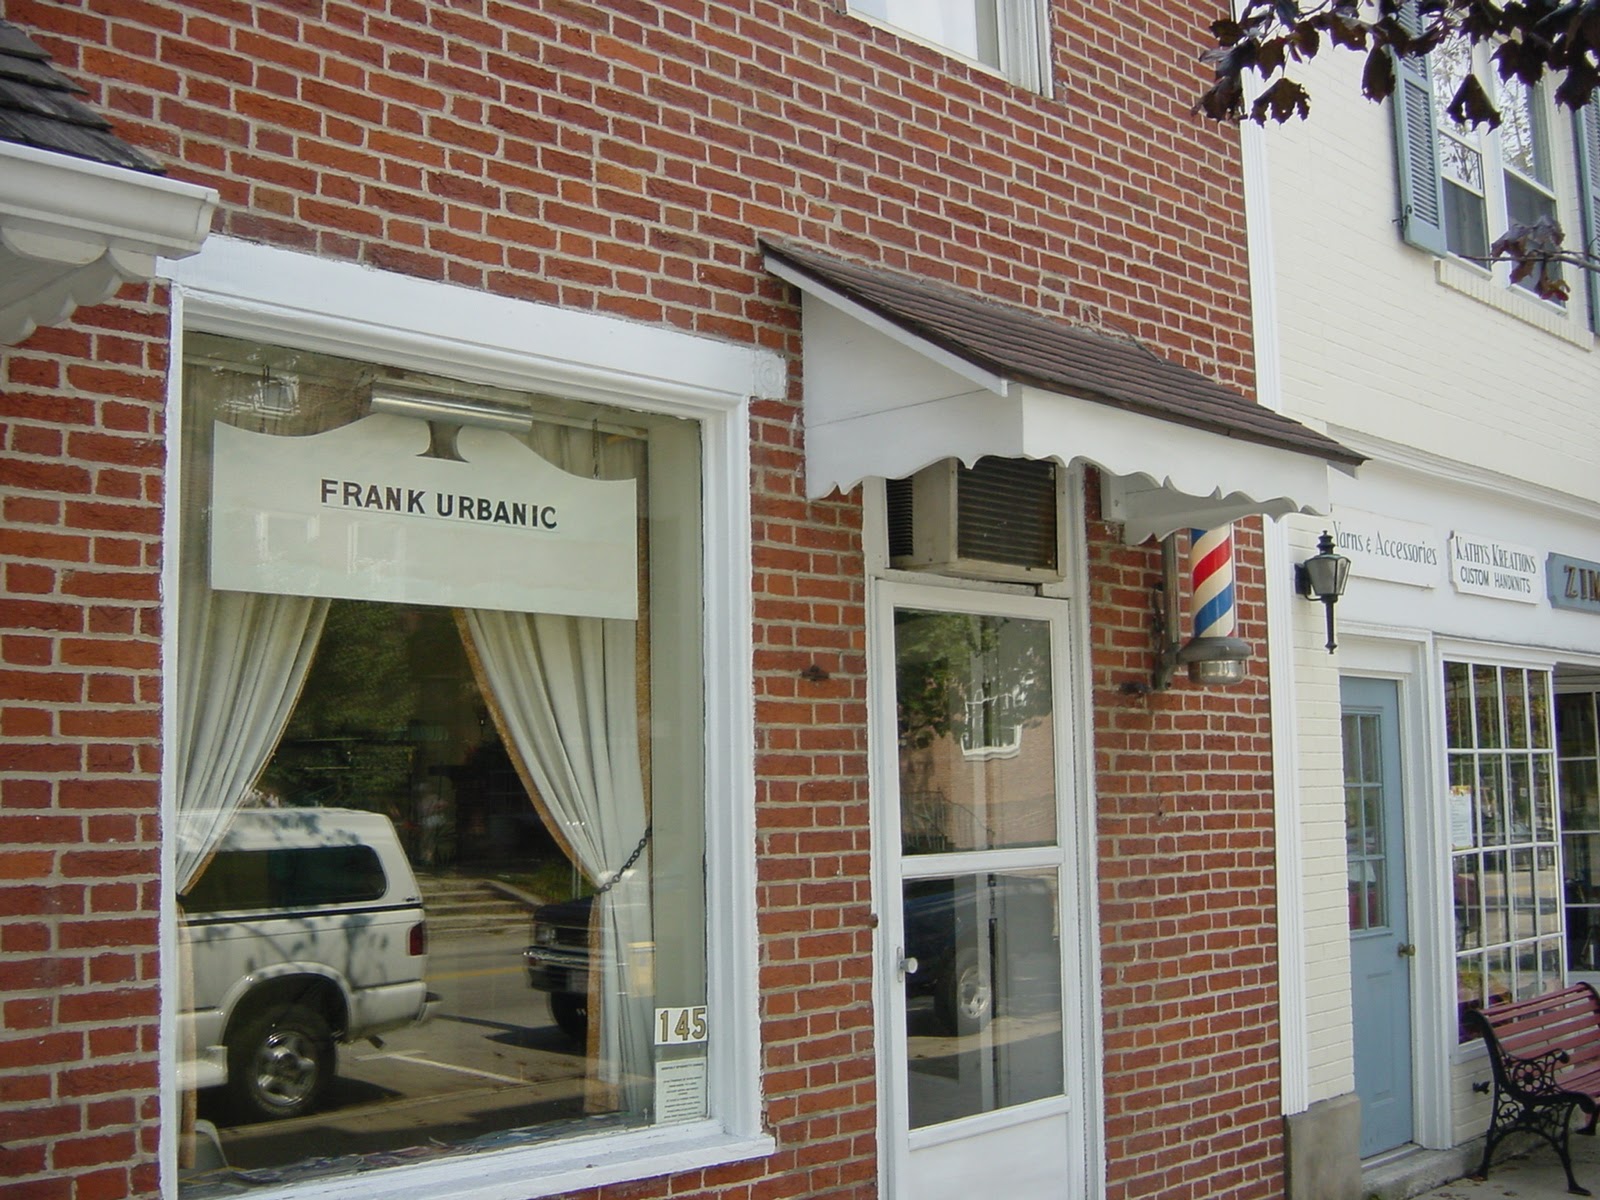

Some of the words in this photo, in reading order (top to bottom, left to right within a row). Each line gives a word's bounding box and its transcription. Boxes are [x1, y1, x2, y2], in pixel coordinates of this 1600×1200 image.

[321, 478, 426, 514] FRANK
[436, 493, 558, 529] URBANIC
[1333, 521, 1363, 552] Yarns
[1375, 530, 1437, 566] Accessories
[1491, 543, 1536, 575] KREATIONS
[1460, 565, 1490, 587] CUSTOM
[1494, 572, 1531, 594] HANDKNITS
[660, 1006, 707, 1043] 145
